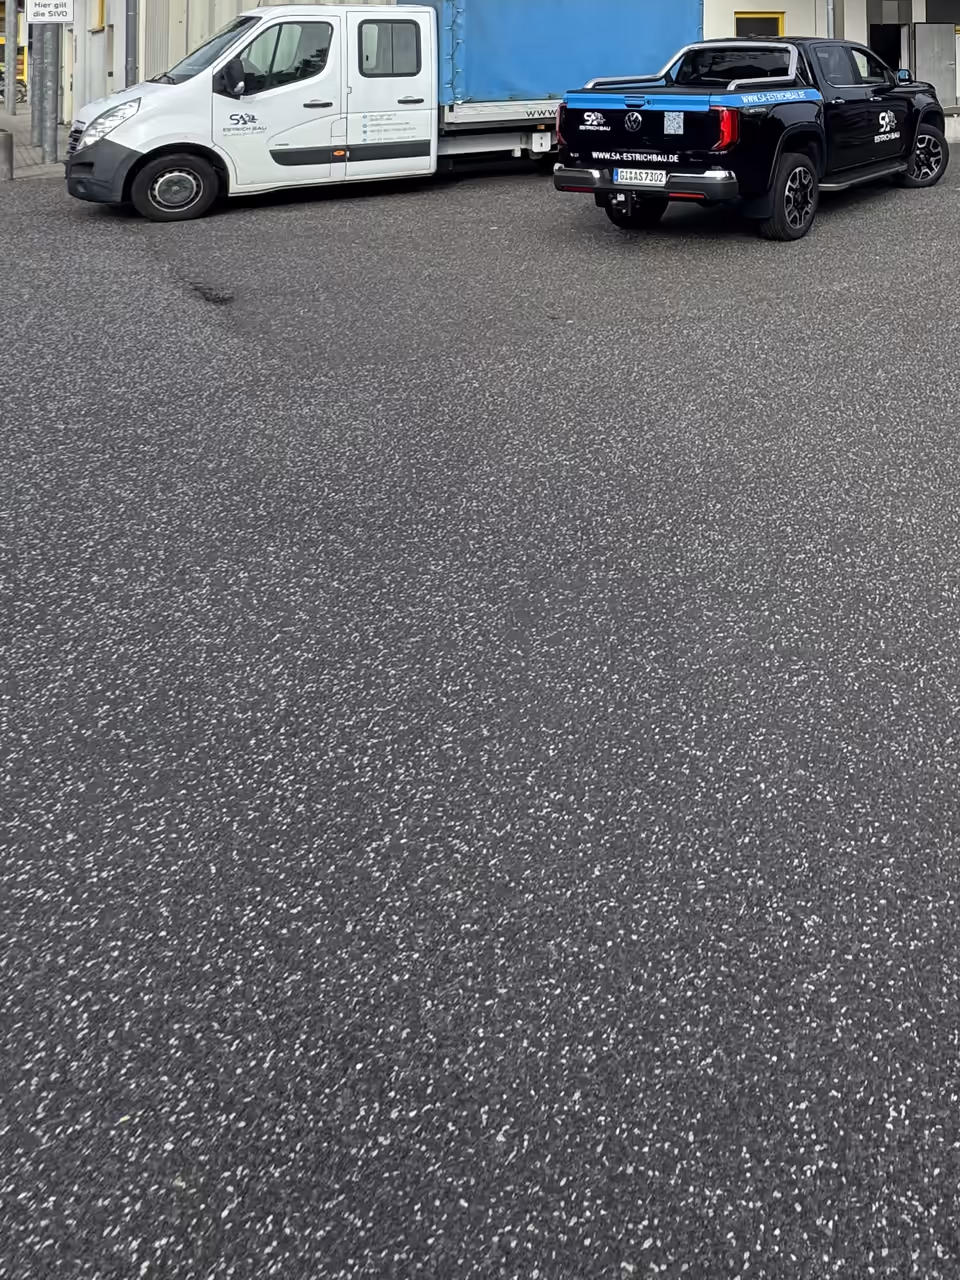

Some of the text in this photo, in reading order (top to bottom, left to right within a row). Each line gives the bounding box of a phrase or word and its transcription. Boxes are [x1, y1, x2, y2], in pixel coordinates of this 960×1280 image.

[53, 1, 67, 10] gilt
[33, 10, 46, 18] die
[590, 150, 680, 163] WWW.SA-ESTRICHBAU.DE
